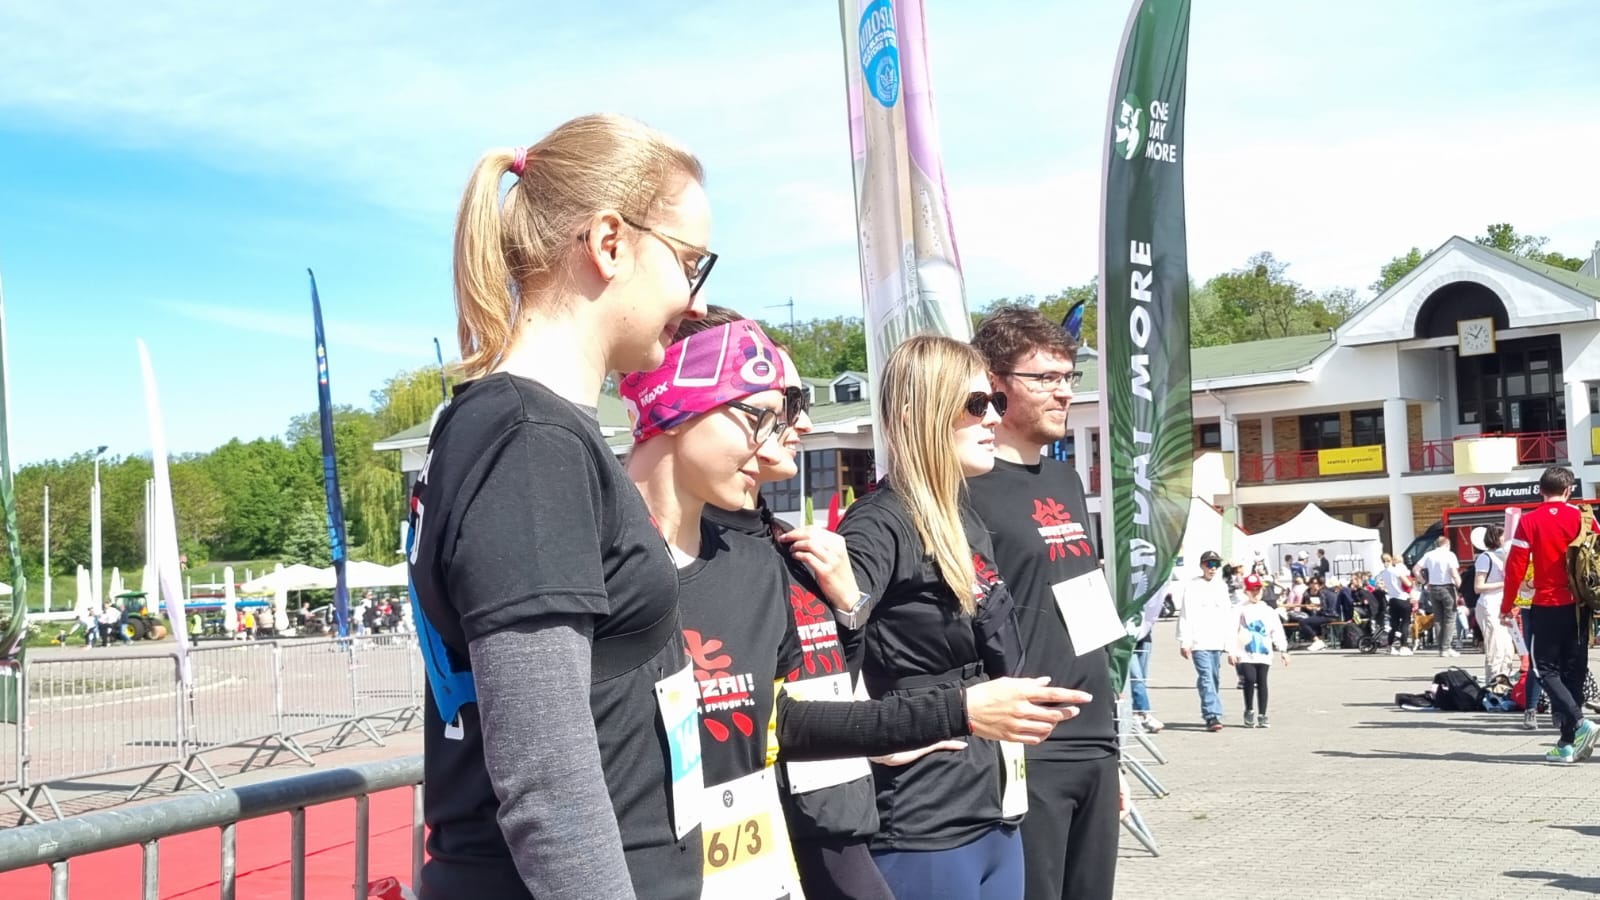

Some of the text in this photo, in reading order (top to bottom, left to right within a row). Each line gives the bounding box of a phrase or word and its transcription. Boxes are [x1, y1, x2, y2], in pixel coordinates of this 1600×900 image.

[1145, 140, 1177, 163] MORE
[1129, 239, 1153, 402] MORE
[1488, 485, 1532, 498] Pastrami
[707, 819, 762, 868] 6/3
